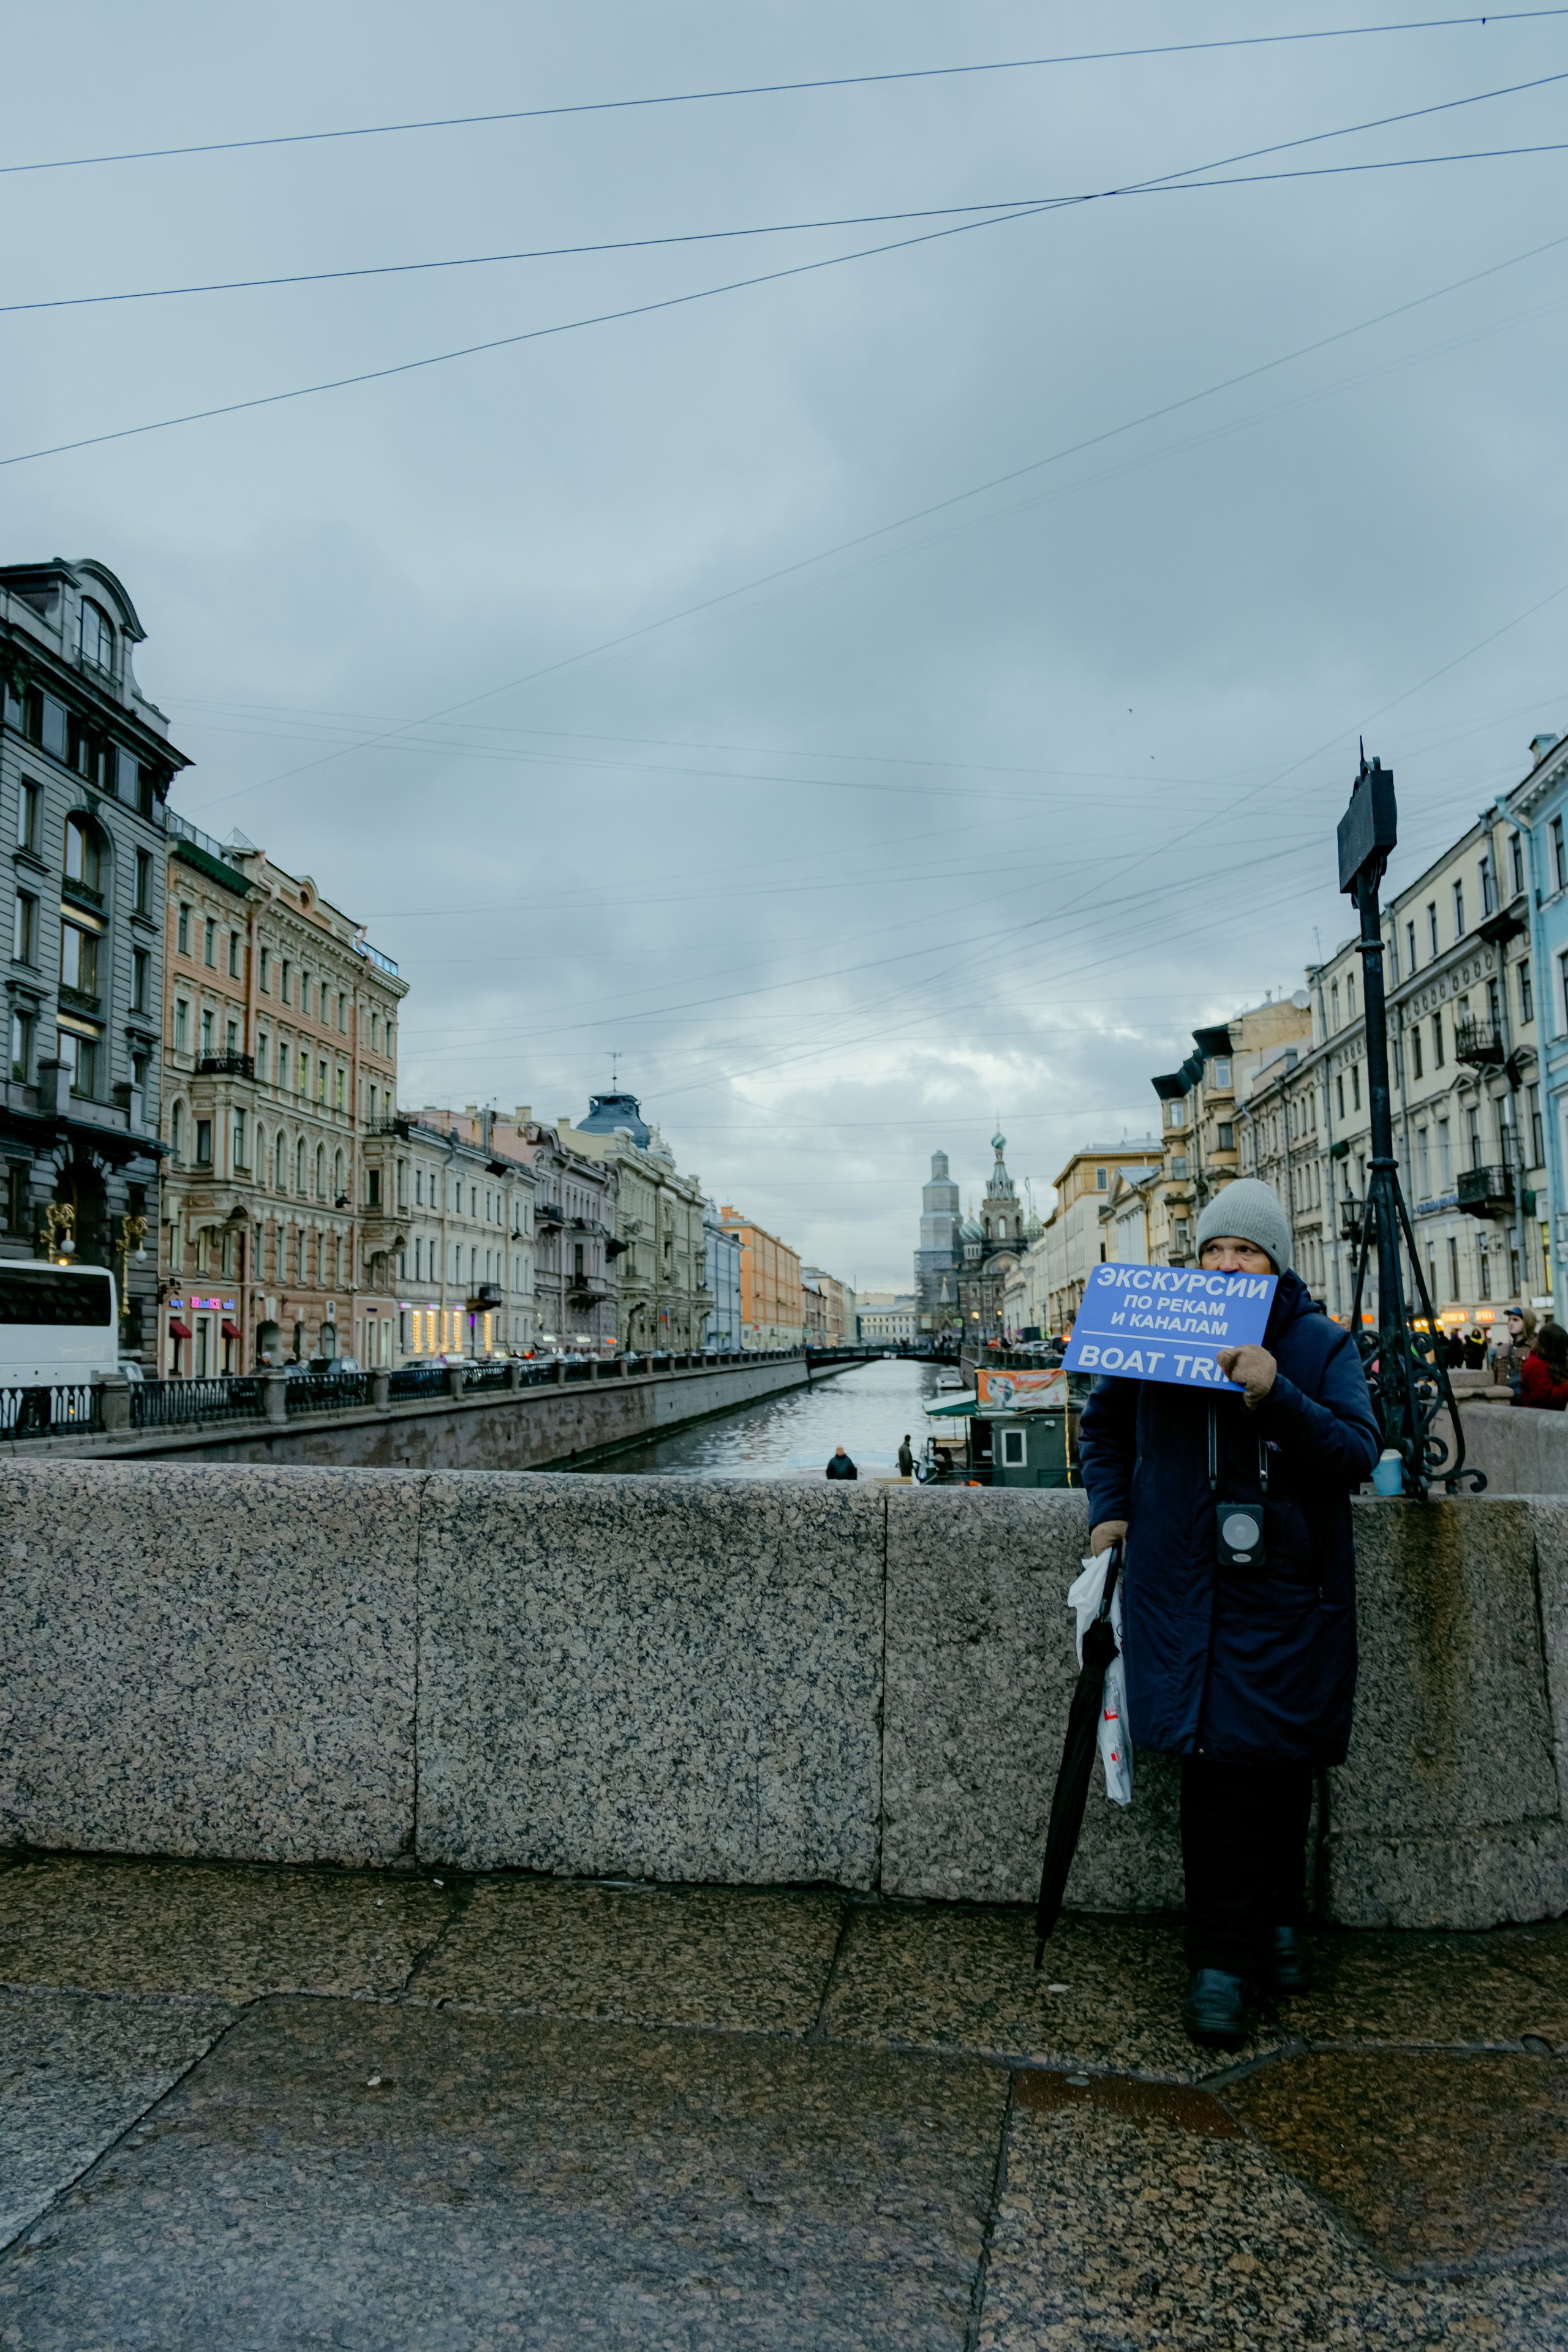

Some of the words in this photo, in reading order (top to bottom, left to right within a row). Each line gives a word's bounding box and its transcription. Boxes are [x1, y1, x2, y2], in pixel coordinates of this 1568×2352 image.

[1096, 1267, 1269, 1300] ЭКСКУРСИИ
[1123, 1294, 1153, 1310] ПО
[1156, 1297, 1226, 1317] РЕКАМ
[1110, 1311, 1126, 1326] И
[1129, 1313, 1229, 1336] КАНАЛАМ
[1078, 1344, 1166, 1374] BOAT
[1174, 1354, 1229, 1383] TRI
